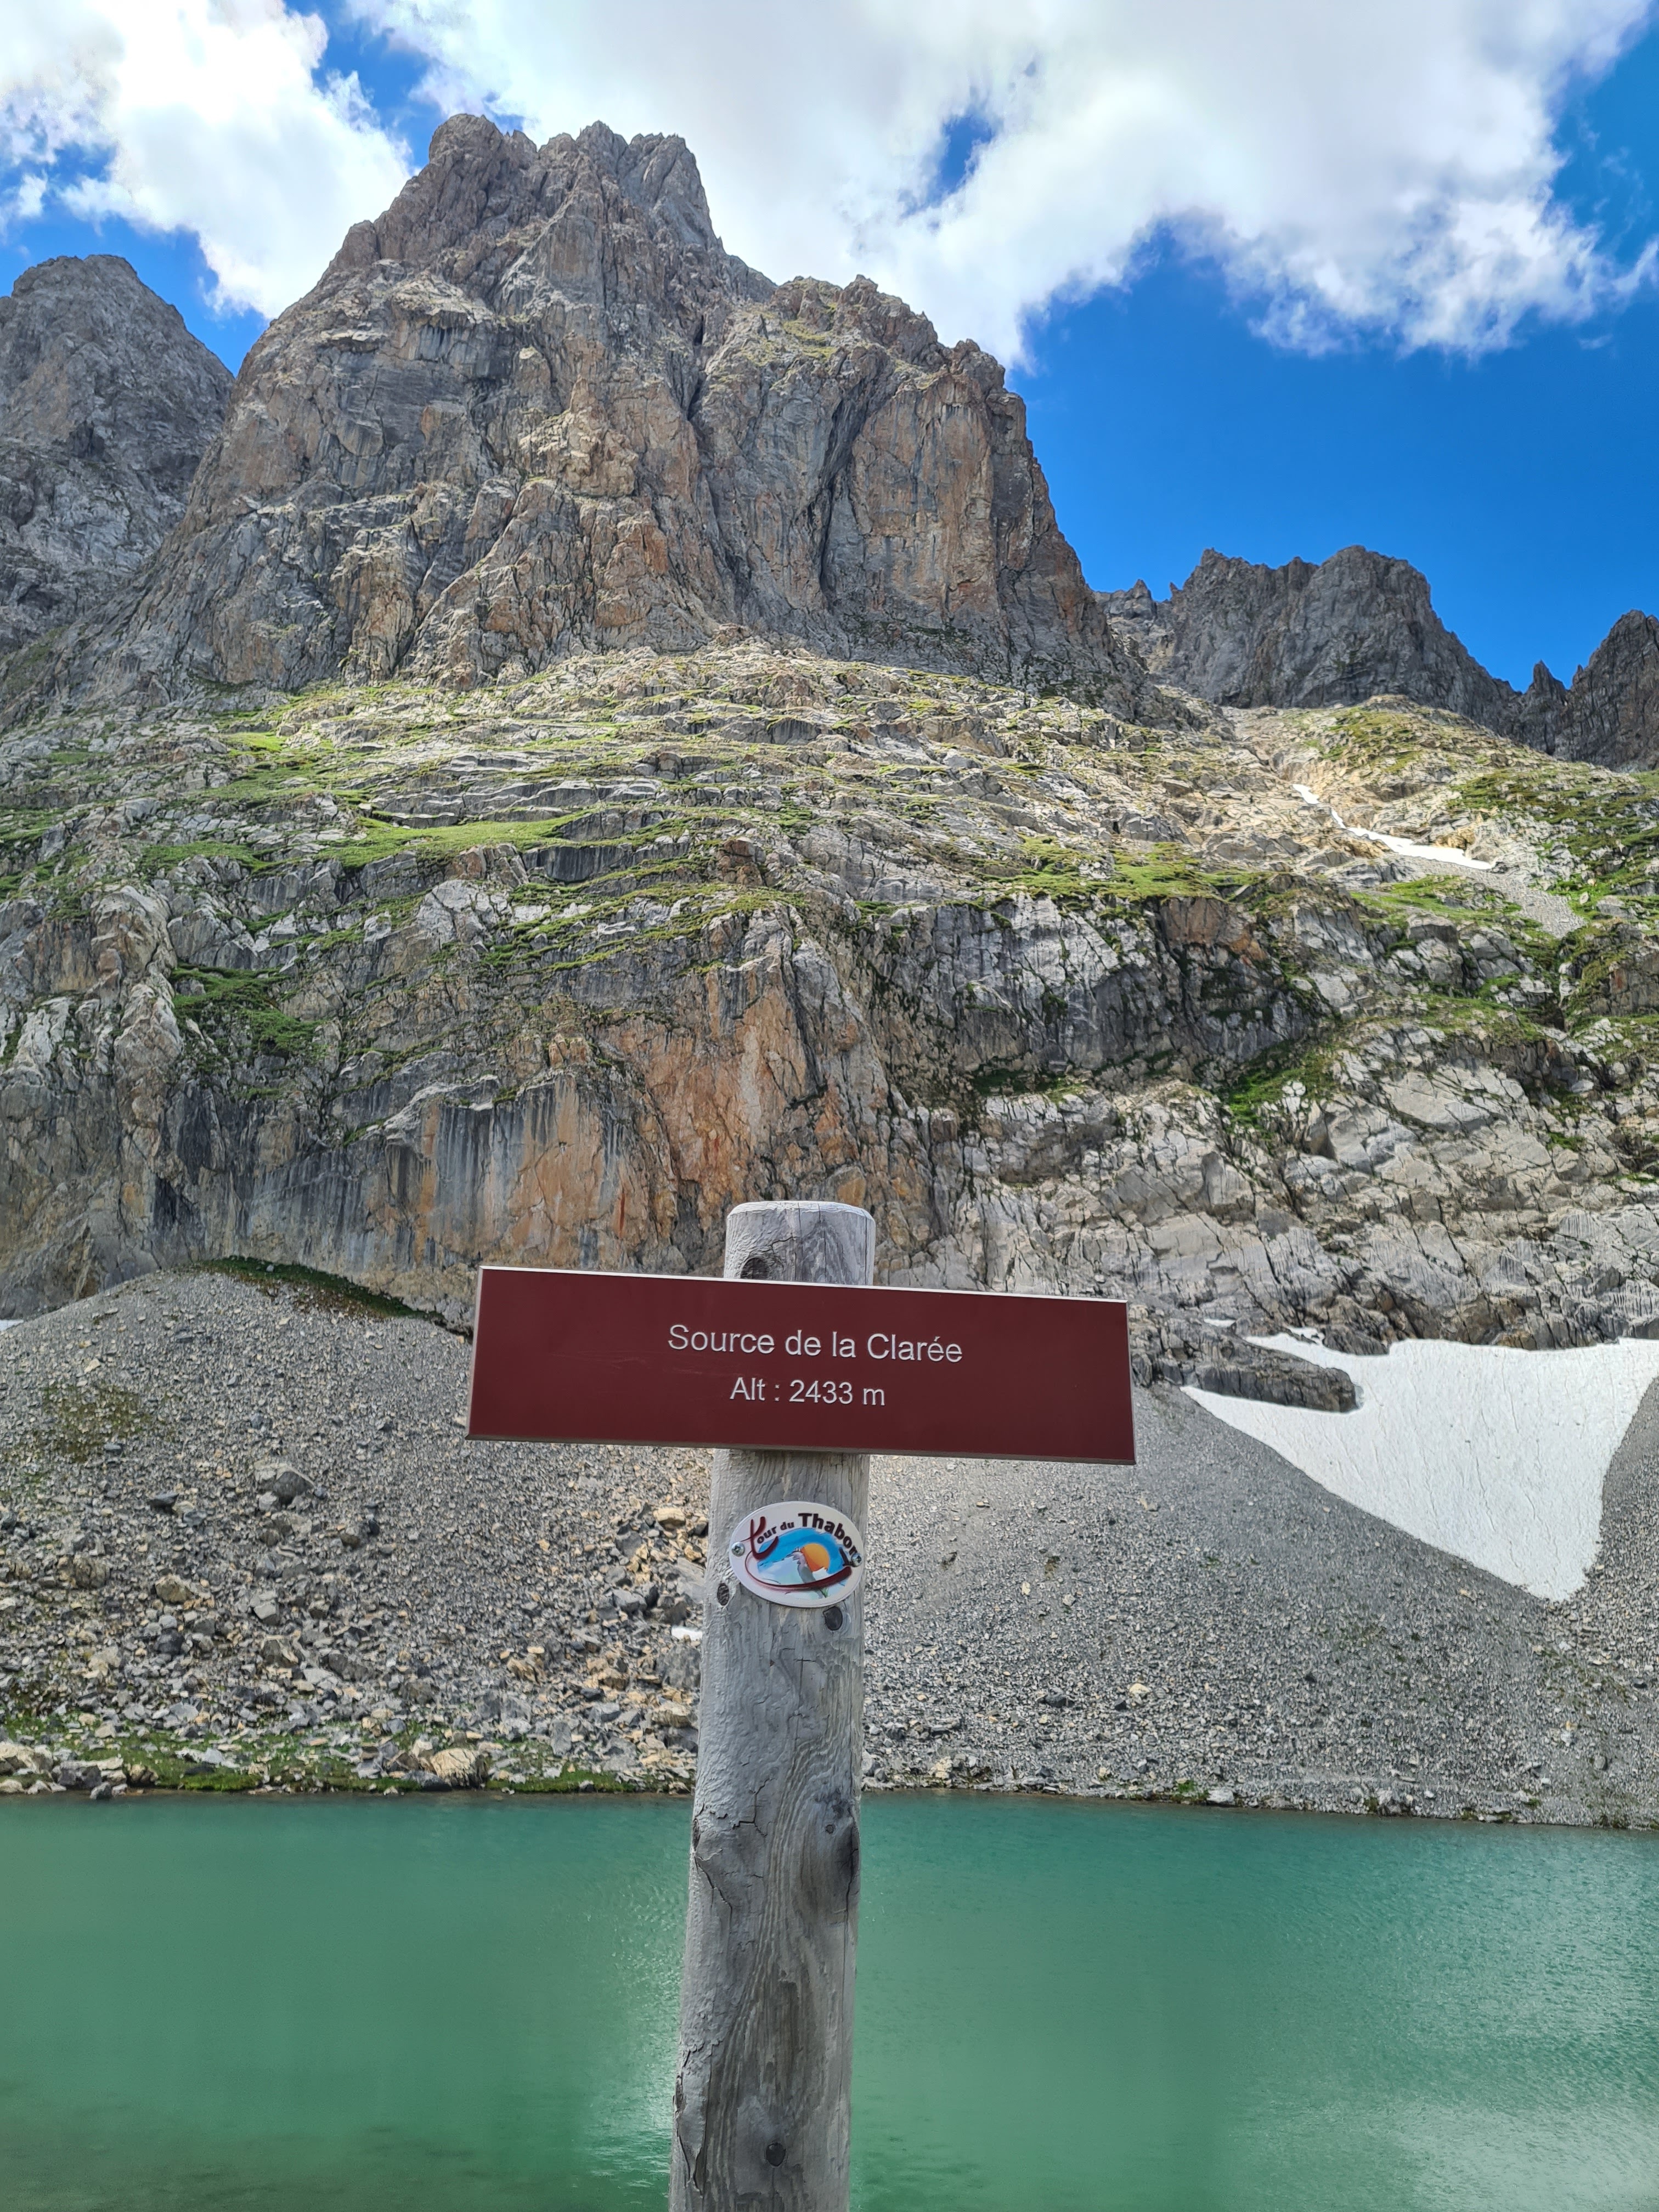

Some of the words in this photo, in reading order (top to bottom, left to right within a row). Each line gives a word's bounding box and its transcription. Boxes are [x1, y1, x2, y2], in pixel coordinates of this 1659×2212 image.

[668, 1324, 775, 1354] Source
[785, 1329, 821, 1357] de
[832, 1331, 856, 1358] la
[867, 1333, 962, 1363] Clarée
[730, 1377, 766, 1401] Alt
[789, 1379, 853, 1404] 2433
[863, 1388, 885, 1406] m
[780, 1521, 795, 1531] du
[798, 1513, 858, 1556] Thabor
